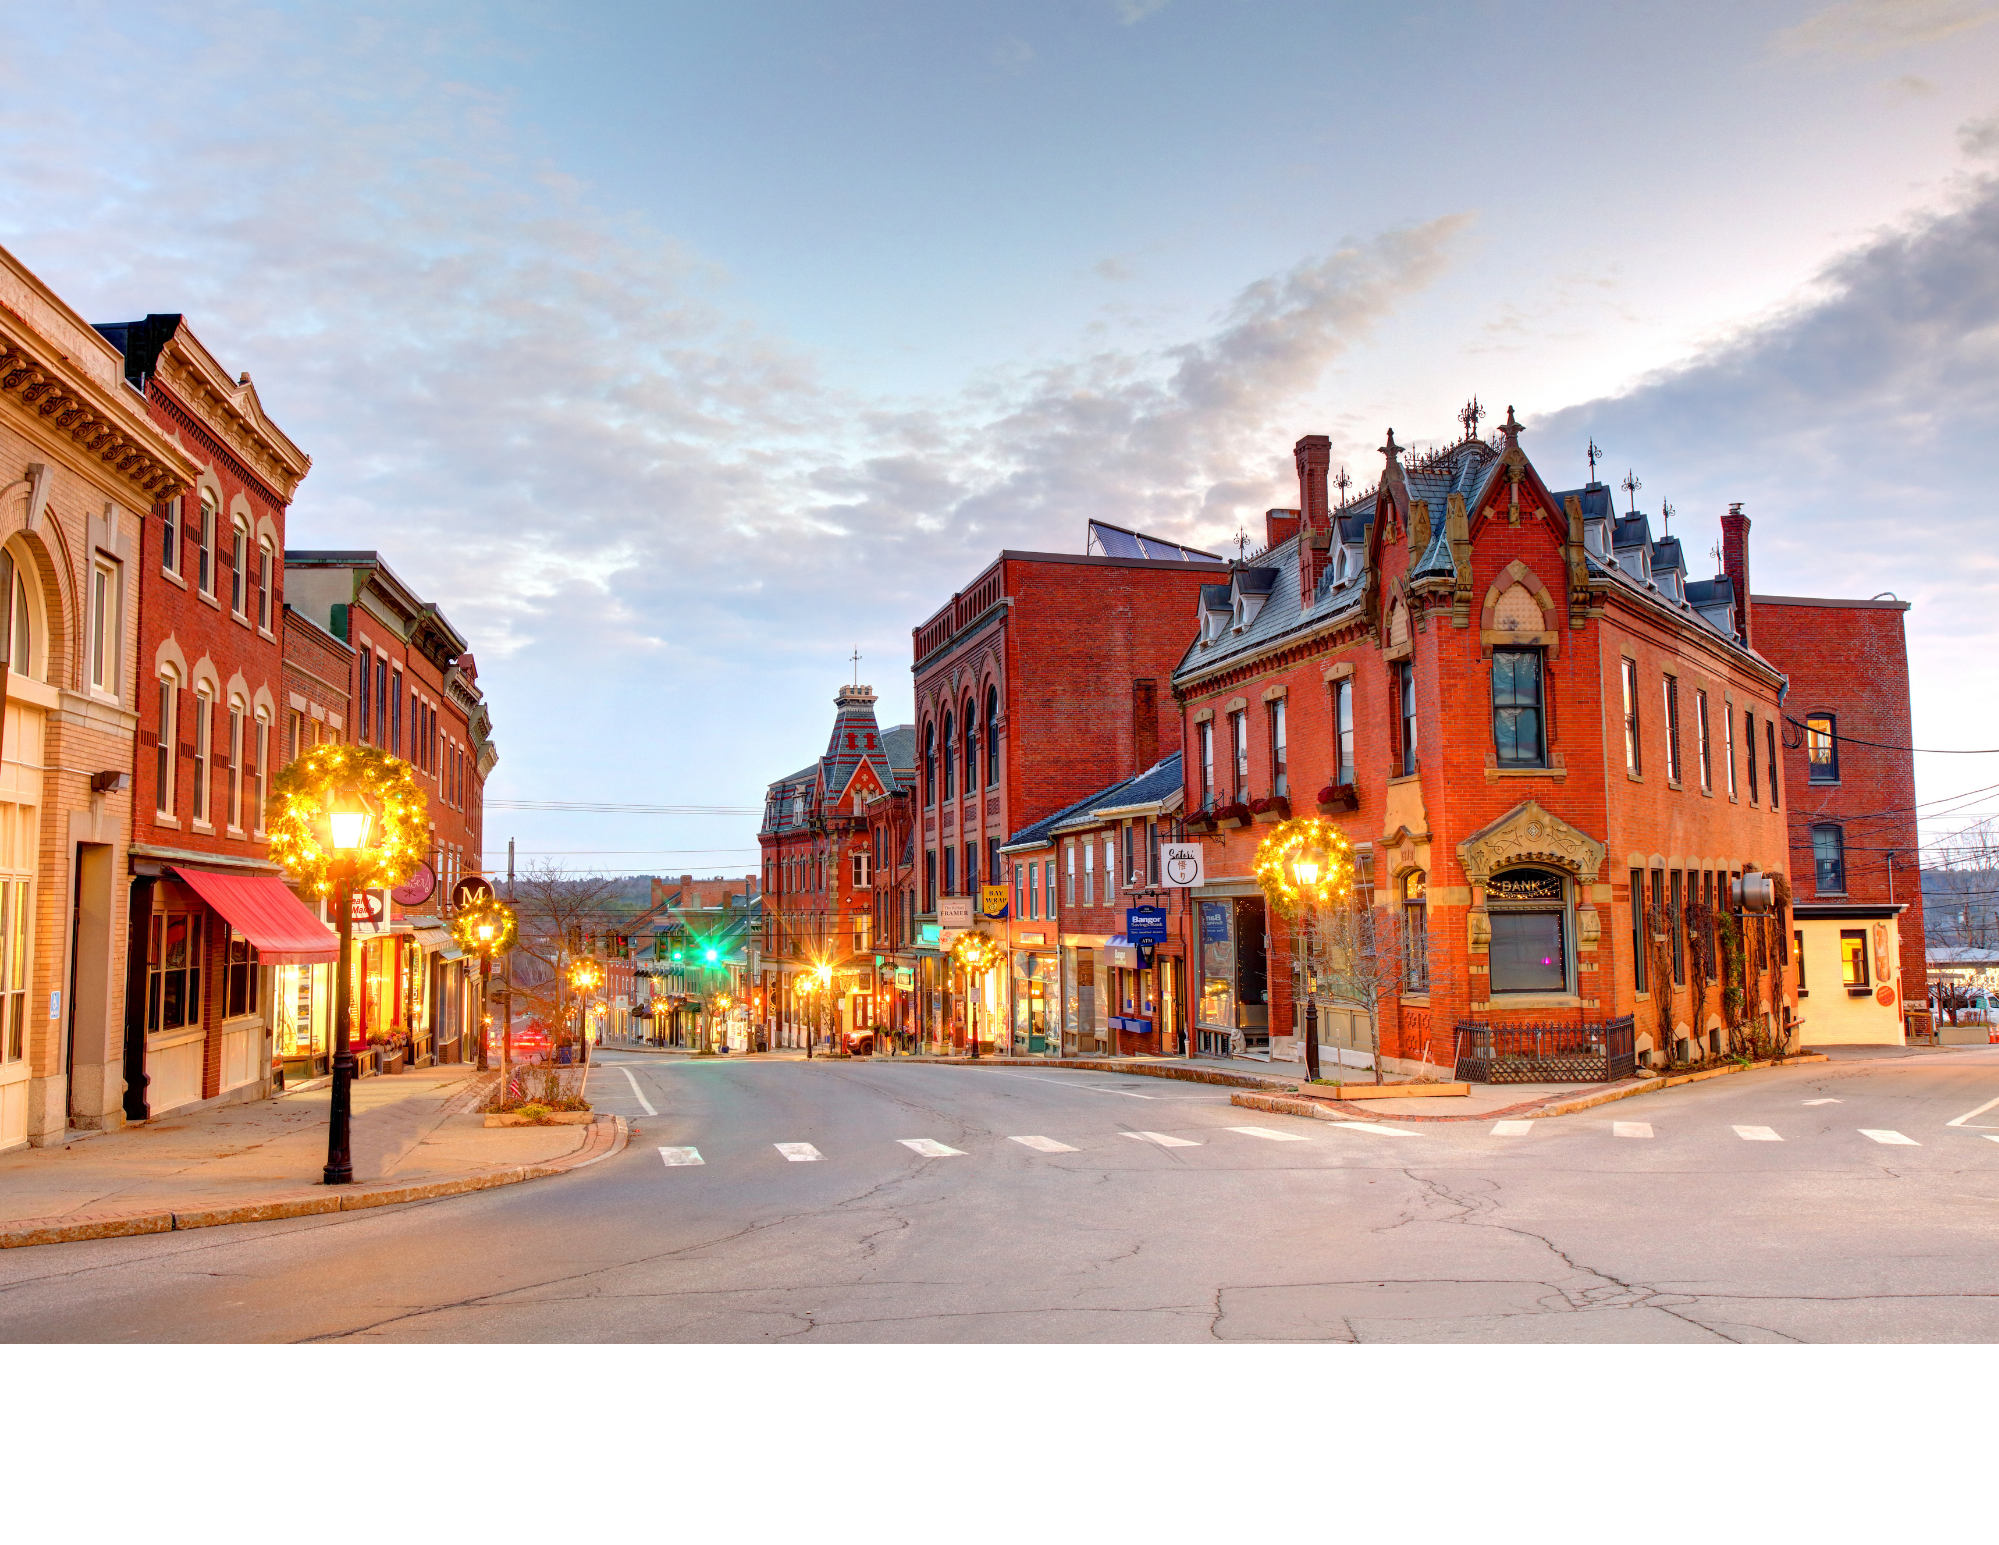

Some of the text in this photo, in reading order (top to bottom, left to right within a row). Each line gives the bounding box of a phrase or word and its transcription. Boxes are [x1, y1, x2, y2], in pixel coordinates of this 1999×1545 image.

[1168, 848, 1195, 859] Satori
[1502, 880, 1540, 892] BANK
[1132, 915, 1162, 924] Bangor
